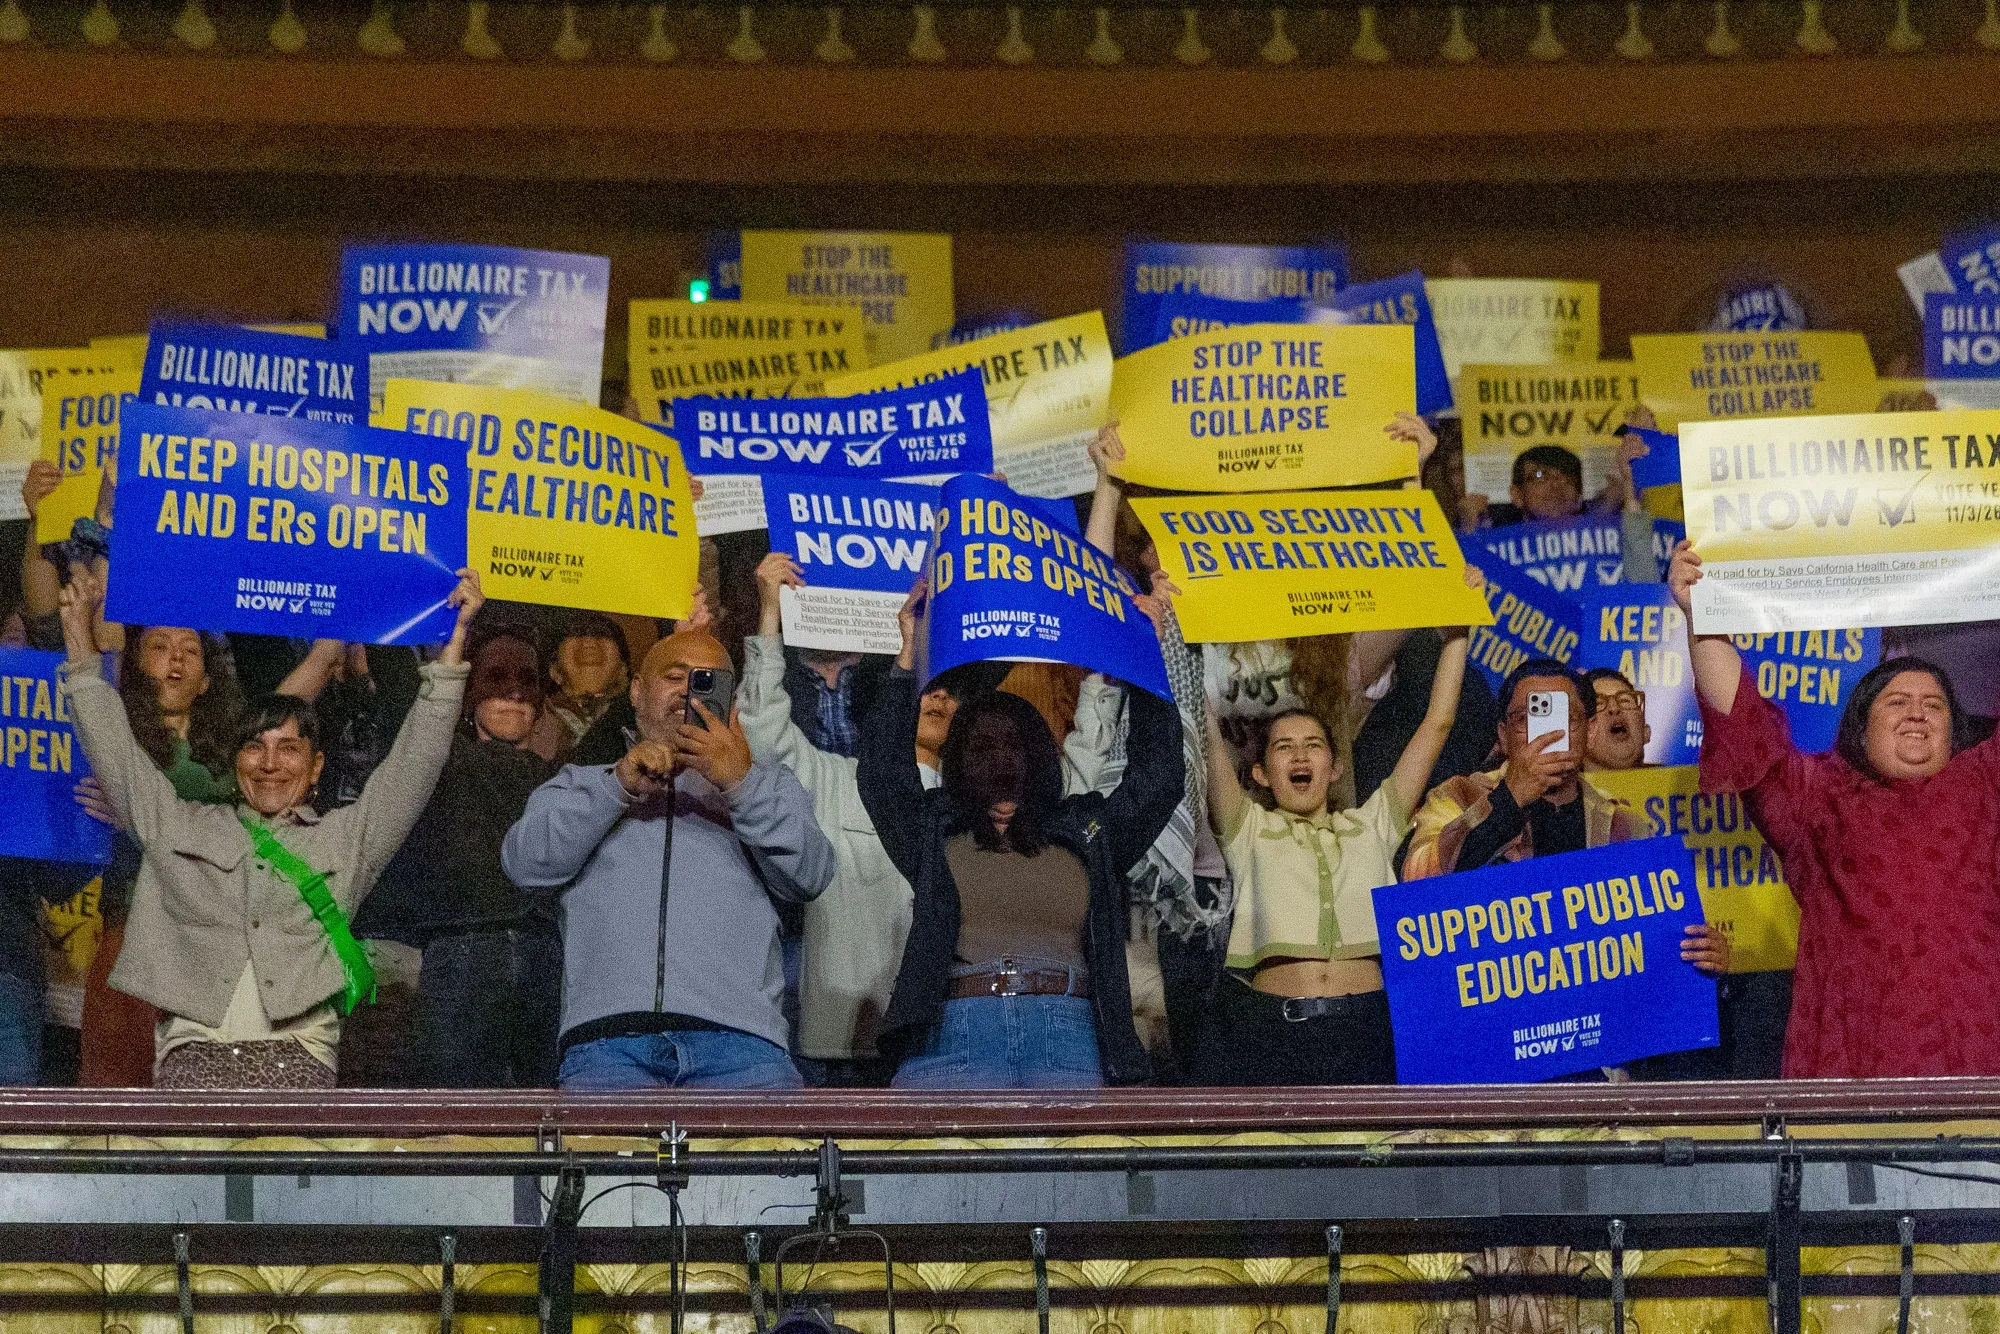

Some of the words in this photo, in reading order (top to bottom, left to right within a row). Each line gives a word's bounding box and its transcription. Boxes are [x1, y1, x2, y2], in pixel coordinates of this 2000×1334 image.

[802, 245, 852, 269] STOP
[858, 246, 893, 269] THE
[360, 262, 529, 297] BILLIONAIRE
[538, 268, 587, 301] TAX
[787, 273, 908, 297] HEALTHCARE
[1136, 264, 1244, 298] SUPPORT
[1252, 268, 1336, 300] PUBLIC
[358, 298, 468, 335] NOW
[1542, 297, 1582, 321] TAX
[648, 316, 794, 340] BILLIONAIRE
[1193, 341, 1261, 370] STOP
[1271, 341, 1324, 368] THE
[1703, 342, 1754, 364] STOP
[1761, 340, 1798, 361] THE
[159, 343, 311, 396] BILLIONAIRE
[315, 360, 354, 401] TAX
[651, 352, 800, 390] BILLIONAIRE
[806, 349, 850, 373] TAX
[1690, 361, 1823, 389] HEALTHCARE
[1171, 374, 1347, 404] HEALTHCARE
[1478, 377, 1620, 403] BILLIONAIRE
[1708, 386, 1814, 417] COLLAPSE
[698, 407, 898, 436] BILLIONAIRE
[906, 394, 966, 430] TAX
[1189, 406, 1329, 438] COLLAPSE
[1481, 409, 1573, 438] NOW
[59, 438, 87, 471] IS
[406, 407, 501, 456] FOOD
[512, 417, 670, 488] SECURITY
[699, 437, 832, 464] NOW
[899, 435, 934, 451] VOTE
[939, 433, 967, 446] YES
[907, 448, 960, 463] 11/3/26
[1218, 445, 1281, 460] BILLIONAIRE
[1285, 443, 1303, 454] TAX
[1709, 436, 1932, 482] BILLIONAIRE
[1942, 434, 2000, 469] TAX
[138, 432, 238, 484] KEEP
[248, 441, 450, 506] HOSPITALS
[1218, 459, 1260, 473] NOW
[469, 468, 678, 537] EALTHCARE
[788, 493, 936, 532] BILLIONA
[1713, 488, 1859, 533] NOW
[156, 490, 237, 539] AND
[247, 497, 317, 546] ERs
[327, 504, 427, 555] OPEN
[1160, 509, 1255, 536] FOOD
[1261, 507, 1426, 535] SECURITY
[492, 546, 561, 565] BILLIONAIRE
[565, 553, 584, 567] TAX
[795, 531, 928, 574] NOW
[960, 498, 1134, 596] HOSPITALS
[1178, 541, 1218, 574] IS
[1223, 540, 1447, 570] HEALTHCARE
[1652, 532, 1675, 560] AX
[490, 561, 537, 578] NOW
[964, 542, 1033, 582] ERs
[1042, 557, 1126, 623] OPEN
[1707, 569, 1720, 579] Ad
[1723, 568, 1745, 580] paid
[1747, 567, 1760, 577] for
[1763, 567, 1775, 578] by
[1778, 566, 1804, 576] Save
[1806, 562, 1854, 575] California
[1857, 560, 1889, 573] Health
[1892, 560, 1916, 570] Care
[1919, 558, 1937, 569] and
[1770, 580, 1782, 590] by
[1785, 578, 1822, 588] Service
[1825, 573, 1881, 587] Employees
[236, 594, 287, 611] NOW
[238, 577, 312, 597] BILLIONAIRE
[315, 583, 337, 599] TAX
[794, 592, 806, 601] Ad
[808, 594, 827, 605] paid
[830, 595, 842, 603] for
[844, 596, 855, 606] by
[858, 597, 880, 606] Save
[1287, 591, 1352, 603] BILLIONAIRE
[1354, 590, 1373, 599] TAX
[800, 602, 849, 615] Sponsored
[851, 607, 862, 617] by
[800, 614, 850, 626] Healthcare
[852, 618, 889, 628] Workers
[962, 610, 1036, 626] BILLIONAIRE
[1039, 614, 1060, 628] TAX
[1291, 603, 1333, 616] NOW
[1600, 606, 1682, 642] KEEP
[794, 622, 843, 635] Employees
[846, 628, 901, 639] International
[962, 623, 1012, 641] NOW
[1497, 593, 1580, 664] PUBLIC
[863, 640, 900, 650] Funding
[1618, 649, 1684, 687] AND
[1758, 660, 1841, 706] OPEN
[1397, 890, 1558, 961] SUPPORT
[1562, 868, 1685, 931] PUBLIC
[1456, 931, 1645, 1008] EDUCATION
[1513, 1018, 1579, 1044] BILLIONAIRE
[1581, 1013, 1601, 1030] TAX
[1514, 1038, 1559, 1061] NOW
